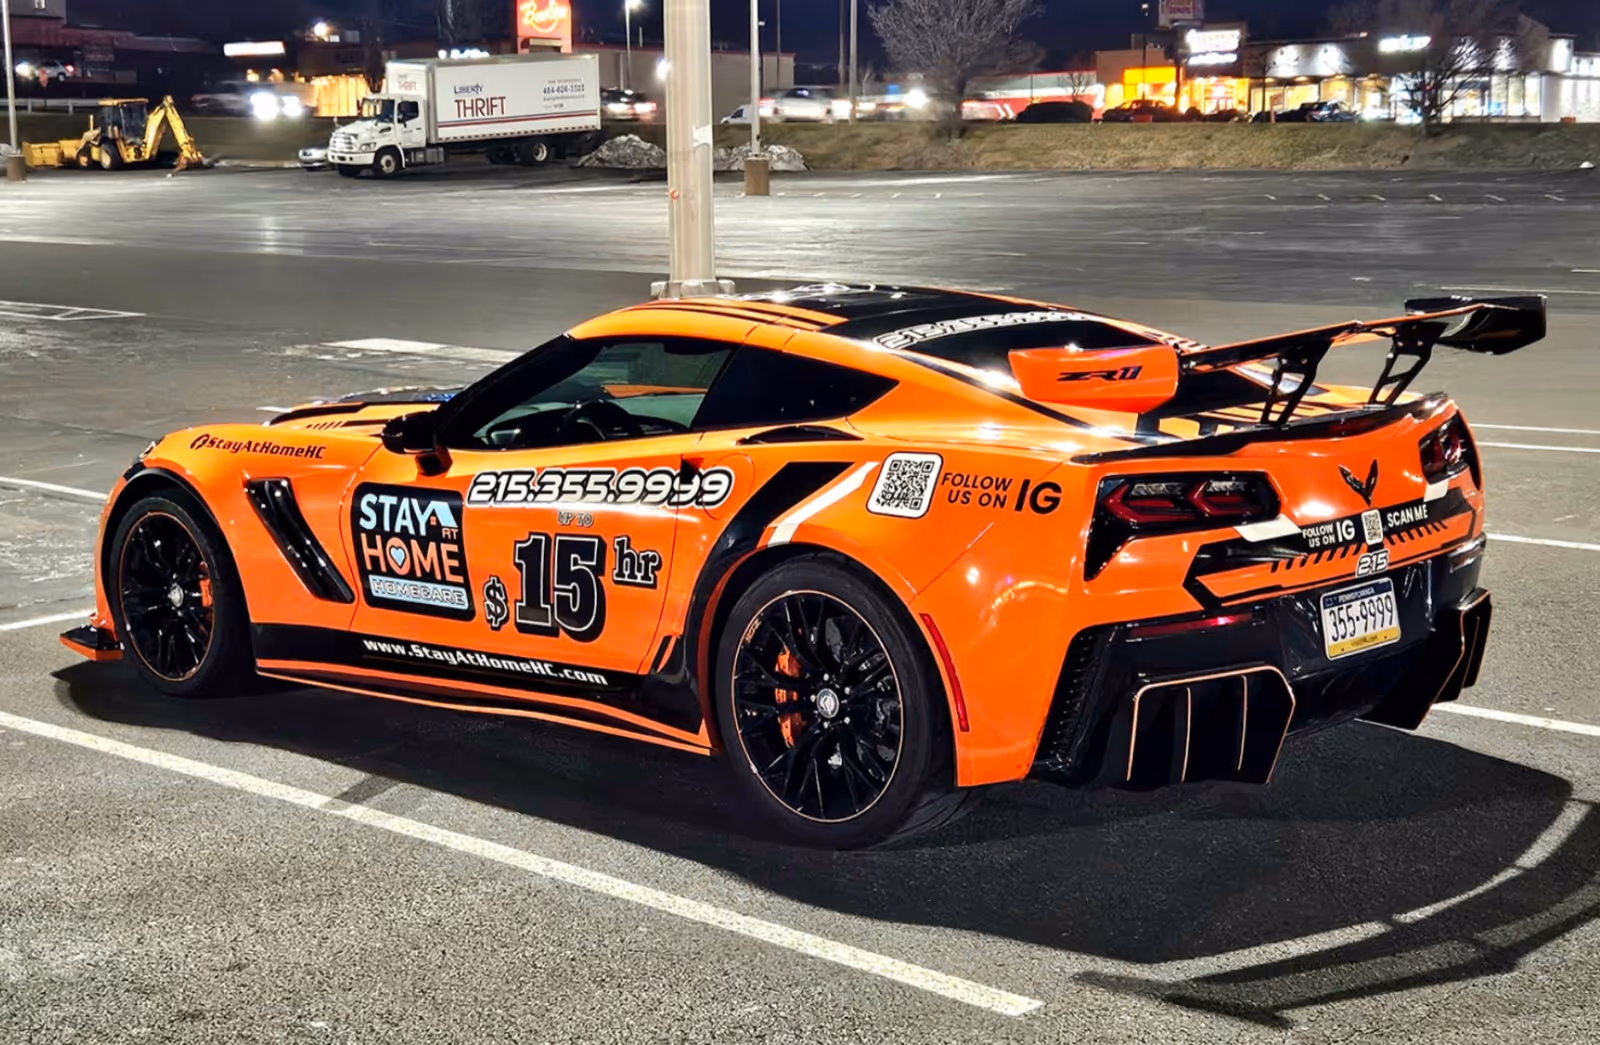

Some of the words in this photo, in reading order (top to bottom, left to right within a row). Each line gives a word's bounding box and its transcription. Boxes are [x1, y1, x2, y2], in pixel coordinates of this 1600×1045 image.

[454, 96, 506, 118] THRIFT
[466, 467, 735, 508] 215.355.9999
[941, 472, 1012, 492] FOLLOW
[948, 489, 971, 505] US
[978, 492, 1007, 508] ON
[1014, 479, 1062, 515] IG
[359, 493, 442, 536] STAY
[557, 511, 573, 525] UP
[574, 512, 593, 528] TO
[1387, 507, 1414, 527] SCAN
[1414, 504, 1428, 520] ME
[442, 528, 459, 540] AT
[1302, 523, 1334, 539] FOLLOW
[1309, 538, 1321, 548] US
[1322, 534, 1336, 545] ON
[1335, 519, 1356, 542] IG
[360, 533, 464, 583] HOME
[613, 535, 662, 589] hr
[1355, 548, 1390, 578] 215
[371, 577, 467, 606] HOMECARE
[1328, 594, 1393, 642] 355-9999
[363, 639, 608, 686] www.StayAtHomeHC.com
